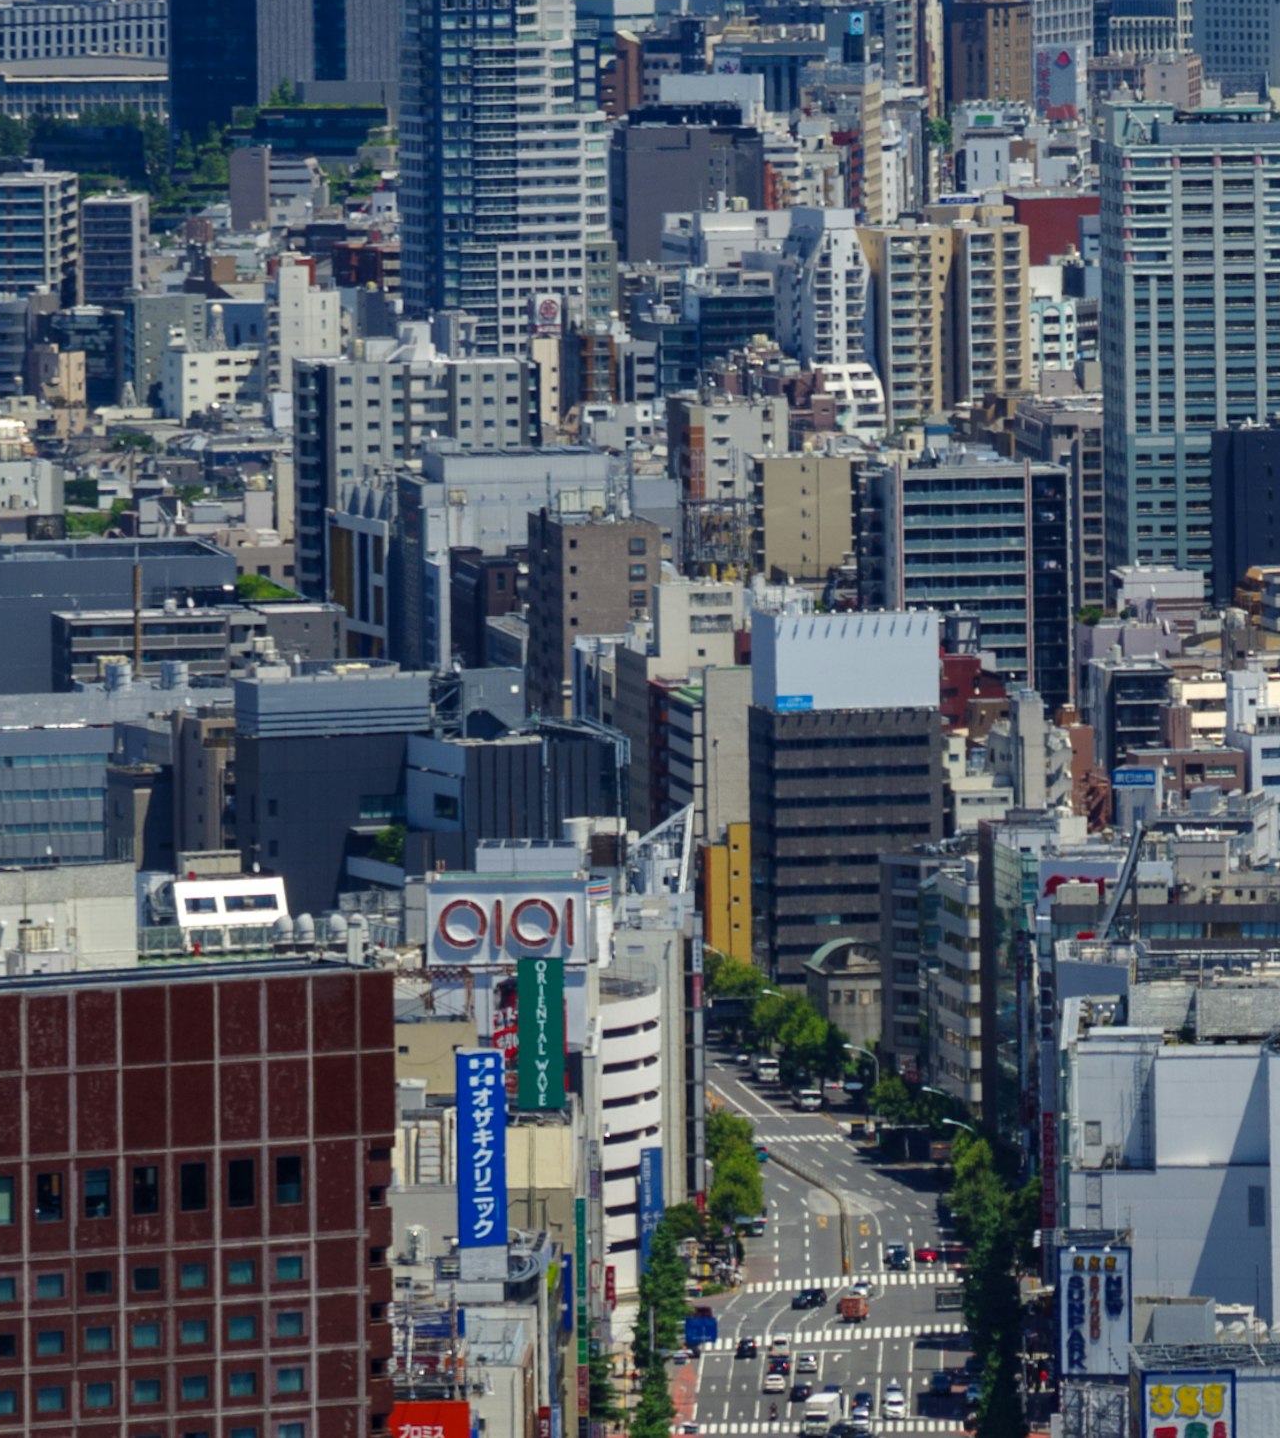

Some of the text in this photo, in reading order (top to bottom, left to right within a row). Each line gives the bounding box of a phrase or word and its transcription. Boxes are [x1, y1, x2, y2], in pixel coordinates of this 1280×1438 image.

[533, 959, 550, 1108] ORIENTAL WAVE
[472, 1088, 496, 1240] オザキクリニック
